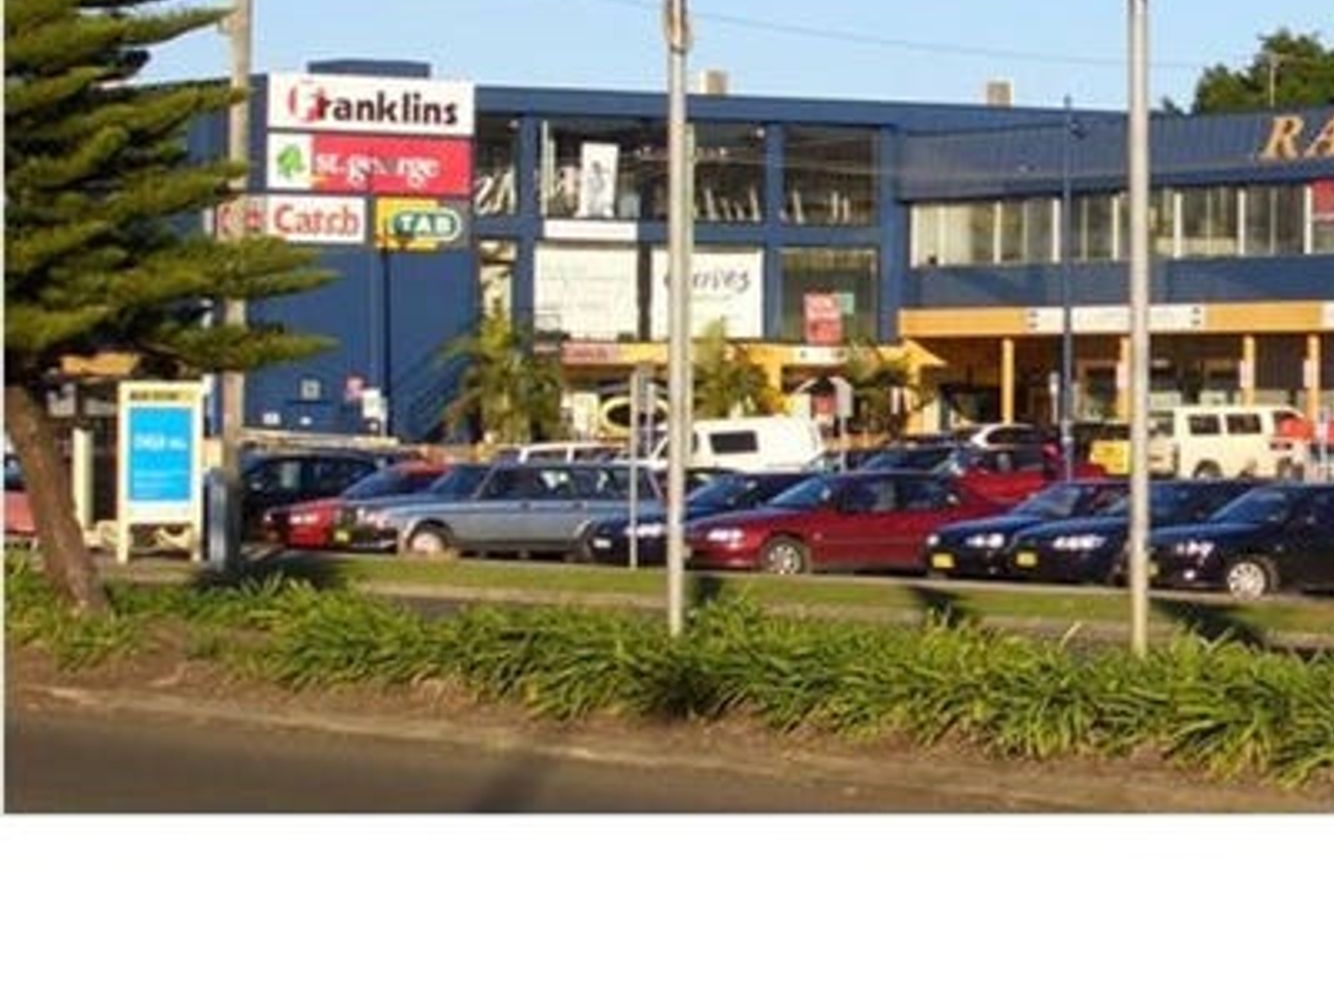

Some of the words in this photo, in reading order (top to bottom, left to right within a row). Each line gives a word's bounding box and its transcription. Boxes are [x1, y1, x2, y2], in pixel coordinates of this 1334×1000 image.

[286, 81, 460, 126] Franklins
[273, 203, 361, 236] Catch
[400, 214, 453, 234] TAB
